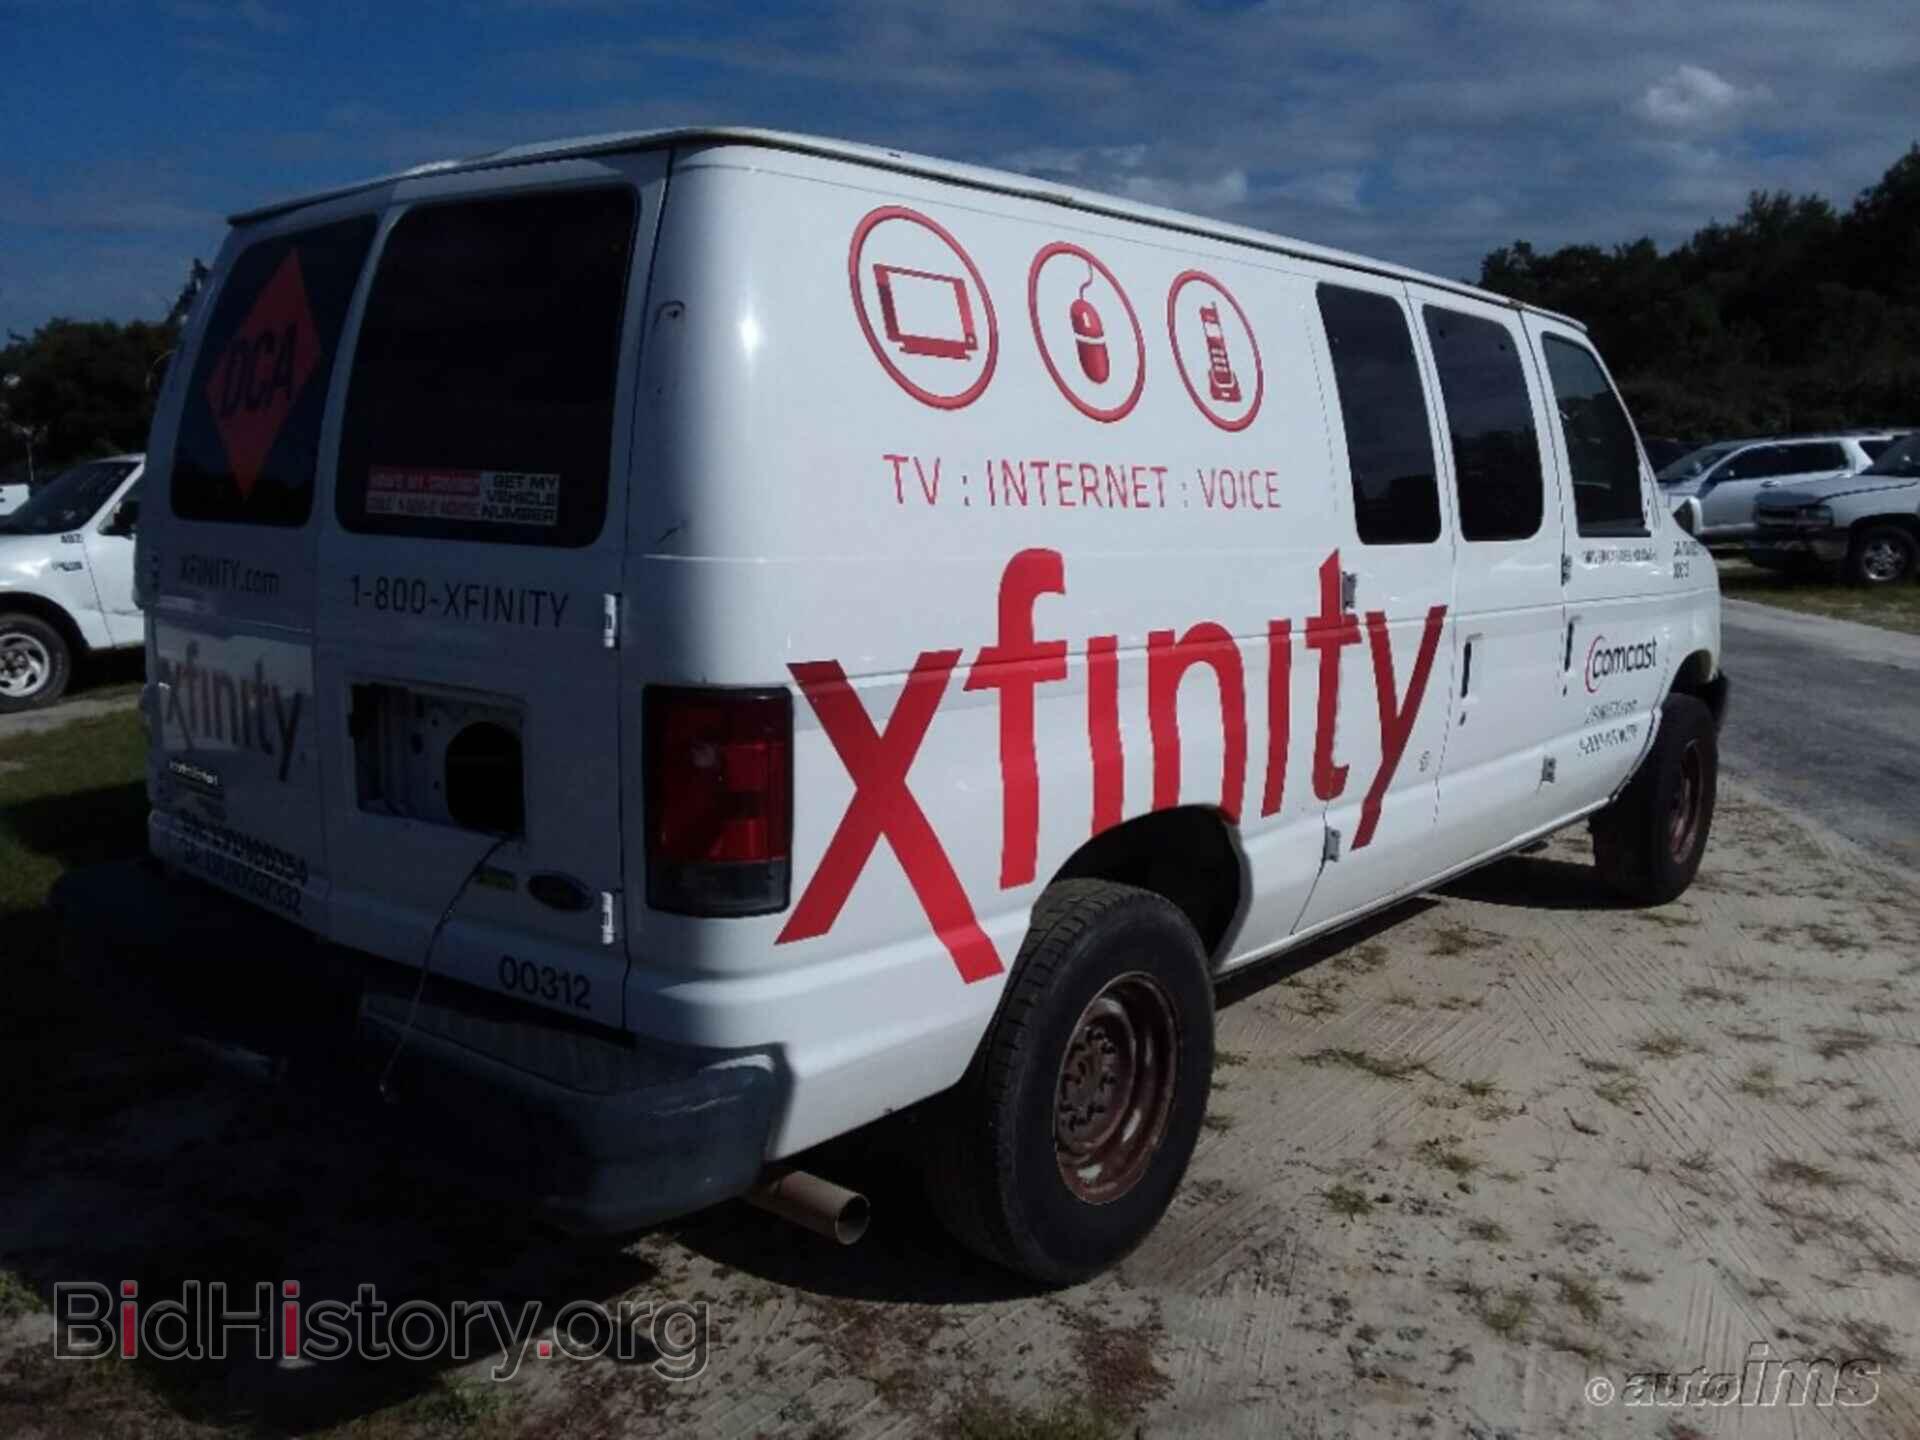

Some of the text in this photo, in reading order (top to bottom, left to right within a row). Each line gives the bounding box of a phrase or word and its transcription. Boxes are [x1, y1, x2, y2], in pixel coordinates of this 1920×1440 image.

[882, 454, 941, 506] TV
[986, 459, 1168, 509] INTERNET
[1197, 468, 1281, 510] VOICE
[481, 504, 557, 522] NUMBER
[179, 554, 280, 596] XFINITY.com
[350, 573, 570, 629] 1-800-XFINITY
[160, 640, 302, 782] xfinity
[774, 547, 1448, 984] xfinity
[499, 954, 592, 1010] 00312
